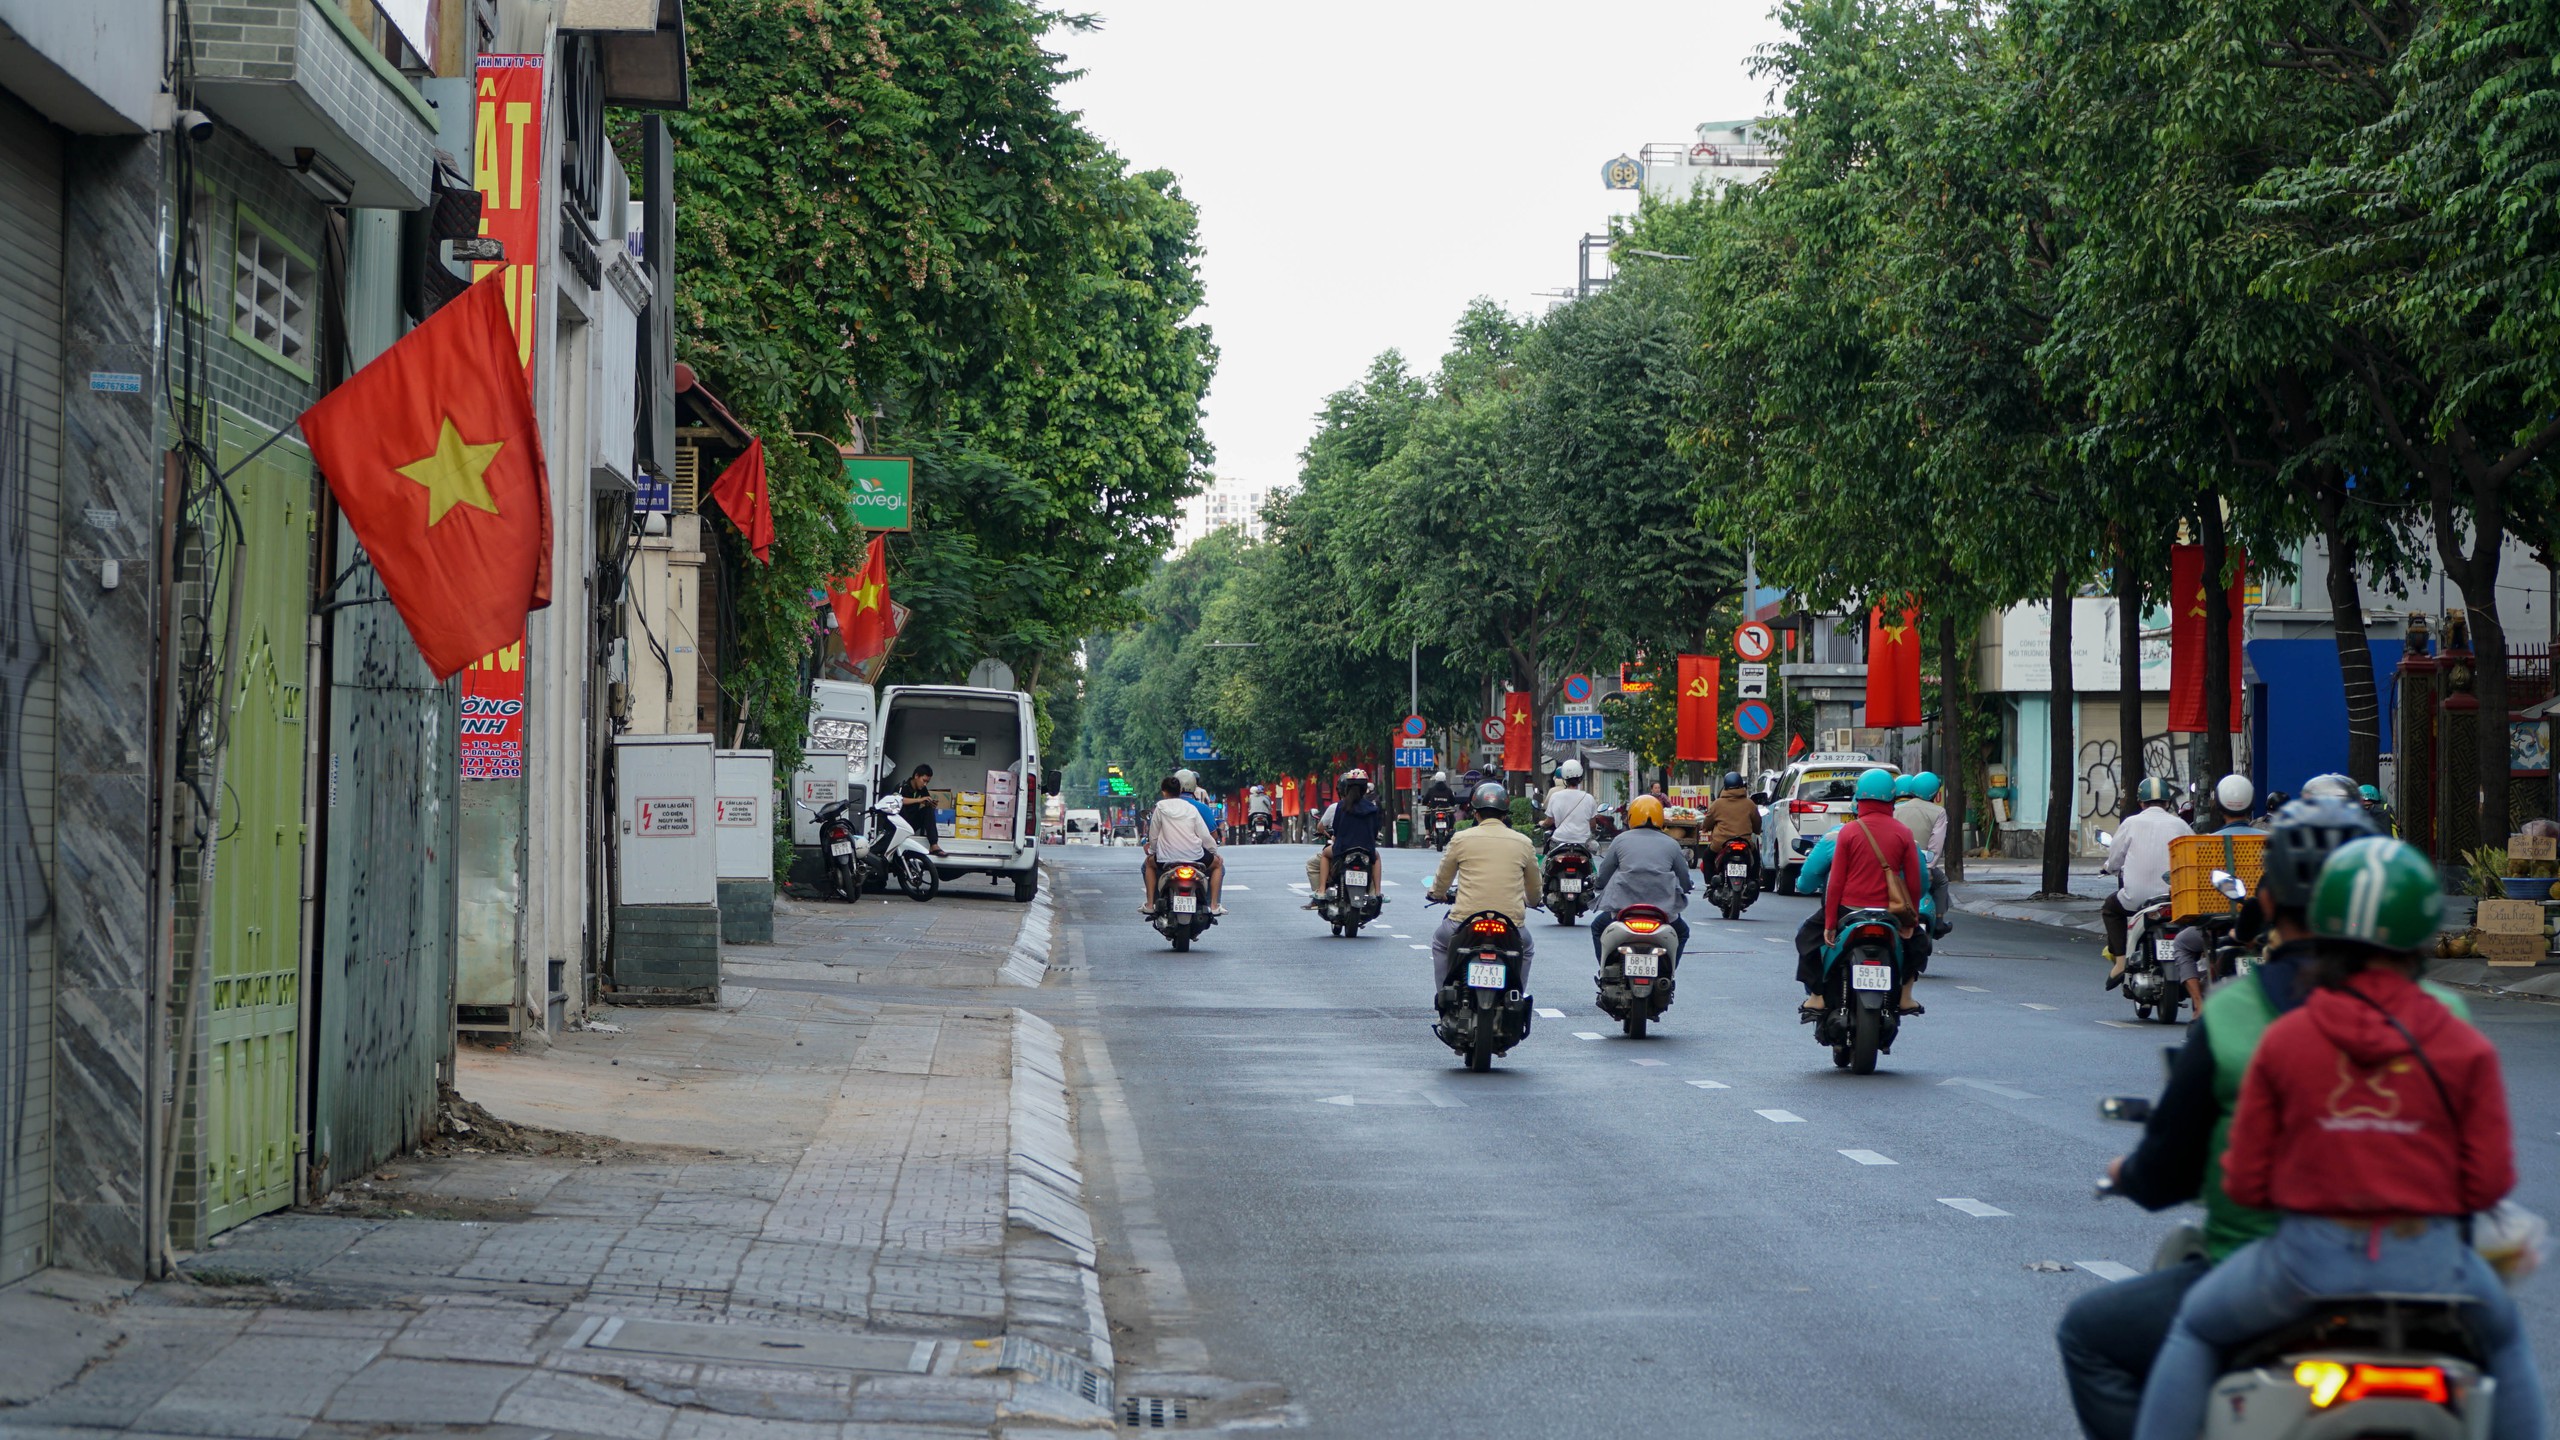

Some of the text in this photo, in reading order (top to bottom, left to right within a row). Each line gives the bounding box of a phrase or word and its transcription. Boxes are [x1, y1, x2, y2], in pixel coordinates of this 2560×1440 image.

[1475, 966, 1499, 976] 77-K1
[1628, 966, 1655, 975] 526.86
[1471, 976, 1502, 986] 313.83
